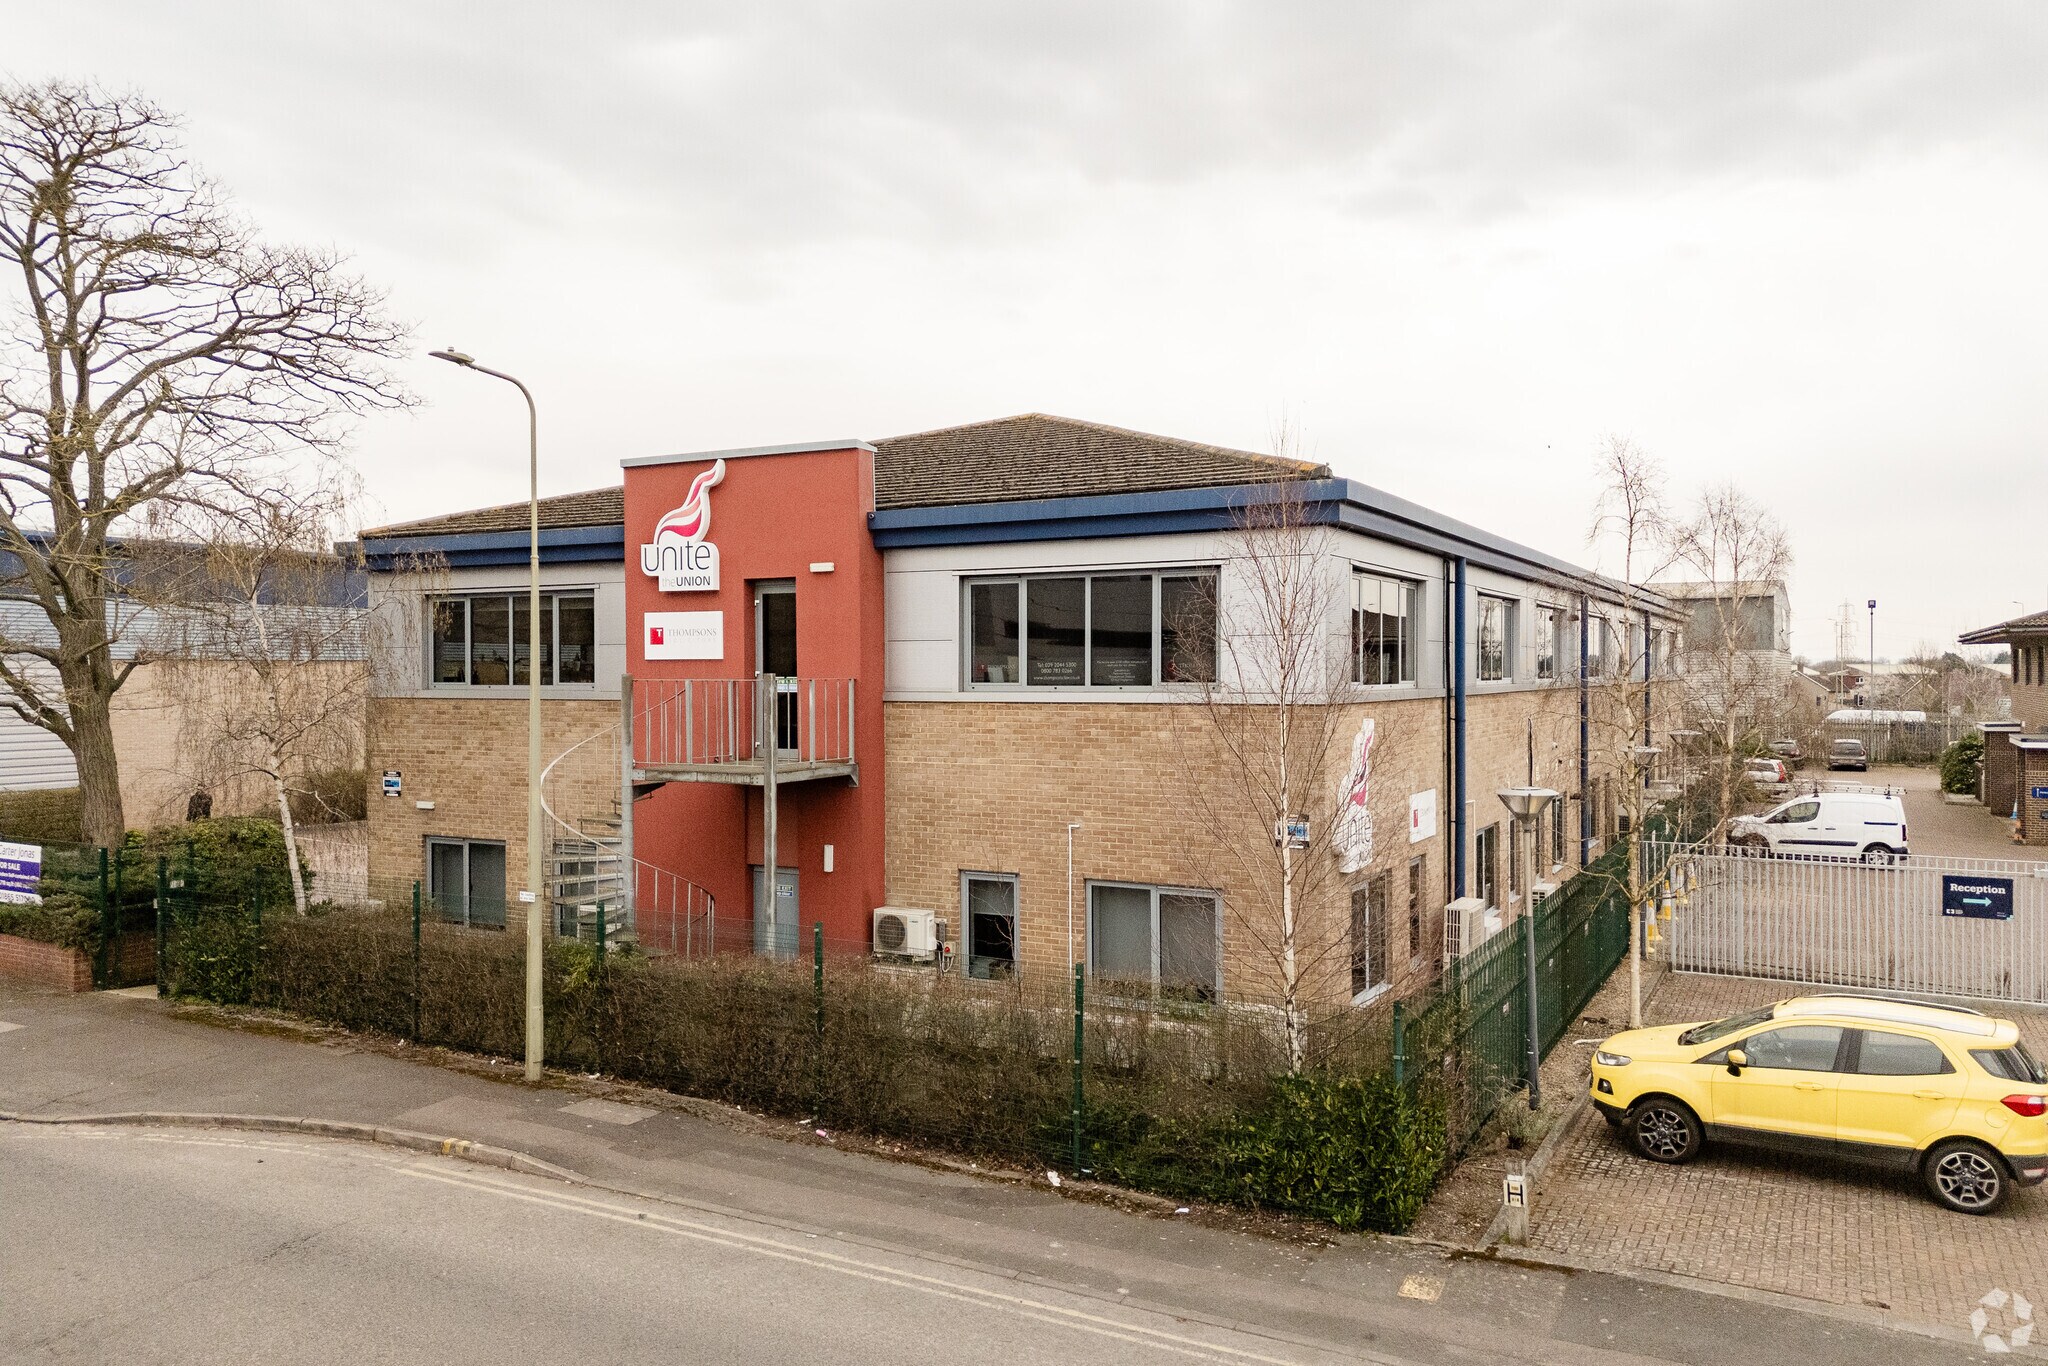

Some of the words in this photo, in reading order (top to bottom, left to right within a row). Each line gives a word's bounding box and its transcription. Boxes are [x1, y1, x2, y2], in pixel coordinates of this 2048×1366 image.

[644, 540, 711, 572] unite
[668, 627, 717, 637] THOMPSONS
[8, 862, 21, 871] SALE
[1950, 883, 2006, 895] Reception
[1507, 1182, 1524, 1205] H
